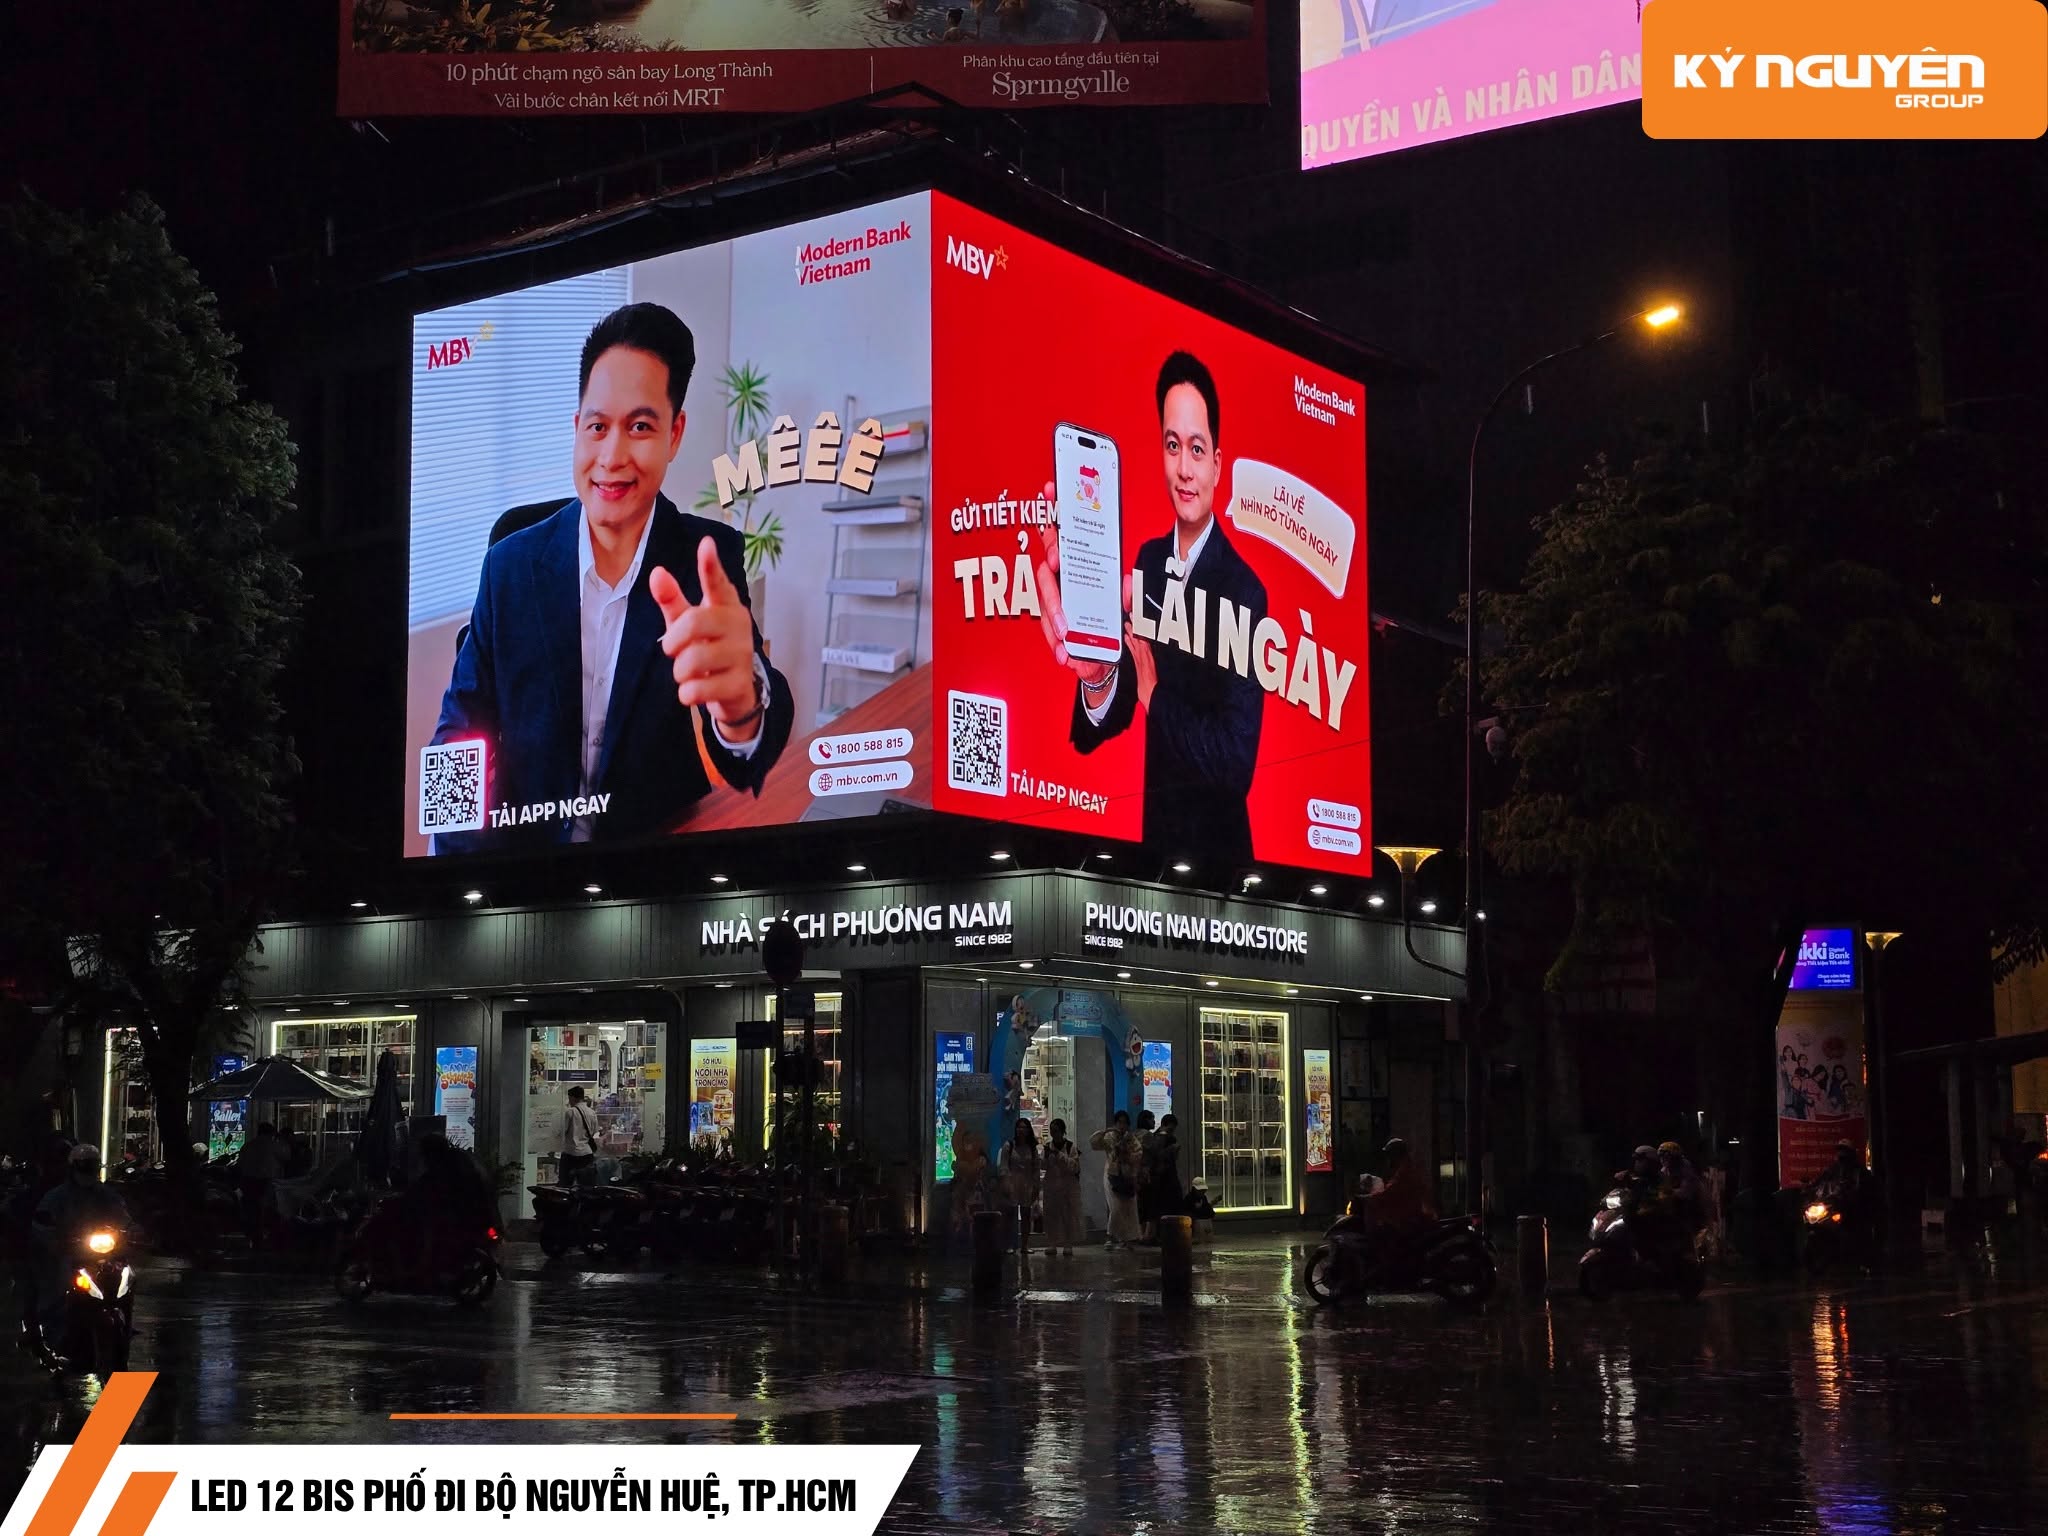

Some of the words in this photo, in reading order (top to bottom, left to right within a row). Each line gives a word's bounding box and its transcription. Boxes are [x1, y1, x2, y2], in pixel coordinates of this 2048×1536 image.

[447, 63, 466, 81] 10
[471, 63, 518, 85] phút
[522, 65, 568, 84] chạm
[572, 65, 602, 84] ngõ
[607, 64, 636, 80] sân
[640, 64, 670, 83] bay
[674, 64, 716, 82] Long
[719, 62, 773, 79] Thành
[1000, 54, 1024, 67] khu
[1027, 57, 1051, 67] cao
[1114, 52, 1139, 65] tiên
[1143, 51, 1159, 67] tại
[494, 93, 520, 109] Vài
[569, 91, 609, 108] chân
[613, 89, 639, 108] kết
[673, 88, 724, 106] MRT
[992, 69, 1130, 101] Springville
[1412, 87, 1452, 133] VÀ
[1465, 67, 1558, 123] NHÂN
[1572, 48, 1642, 100] DÂN
[795, 238, 864, 266] Modern
[866, 219, 912, 249] Bank
[946, 235, 994, 280] MBV
[795, 257, 871, 286] Vietnam
[428, 335, 477, 370] MBV
[1295, 375, 1332, 407] Modern
[1332, 391, 1356, 416] Bank
[1295, 393, 1335, 426] Vietnam
[712, 411, 885, 508] MÊÊÊ
[951, 498, 981, 532] GỬI
[982, 489, 1017, 527] TIẾT
[1020, 492, 1060, 532] KIỆM
[1273, 486, 1289, 506] LÃI
[1291, 494, 1305, 515] VỀ
[1240, 496, 1262, 516] NHÌN
[1264, 505, 1277, 522] RÕ
[1279, 512, 1307, 541] TỪNG
[1309, 532, 1338, 567] NGÀY
[954, 530, 1042, 619] TRẢ
[1132, 556, 1207, 659] LÃI
[1217, 596, 1357, 732] NGÀY
[836, 743, 860, 754] 1800
[864, 740, 882, 751] 588
[887, 738, 903, 748] 815
[836, 772, 898, 787] mbv.com.vn
[1011, 769, 1034, 797] TẢI
[1037, 780, 1066, 804] APP
[1069, 788, 1108, 814] NGAY
[489, 802, 516, 828] TẢI
[519, 801, 556, 825] APP
[560, 793, 611, 819] NGAY
[702, 912, 754, 945] NHÀ
[759, 909, 826, 942] SCH
[833, 903, 942, 937] PHƯƠNG
[949, 900, 1012, 930] NAM
[955, 934, 986, 947] SINCE
[988, 933, 1012, 945] 1982
[1086, 901, 1162, 936] PHUONG
[1166, 912, 1206, 942] NAM
[1210, 919, 1308, 954] BOOKSTORE
[1085, 934, 1106, 947] SINCE
[1107, 937, 1123, 949] 1982
[1829, 951, 1850, 960] Bank
